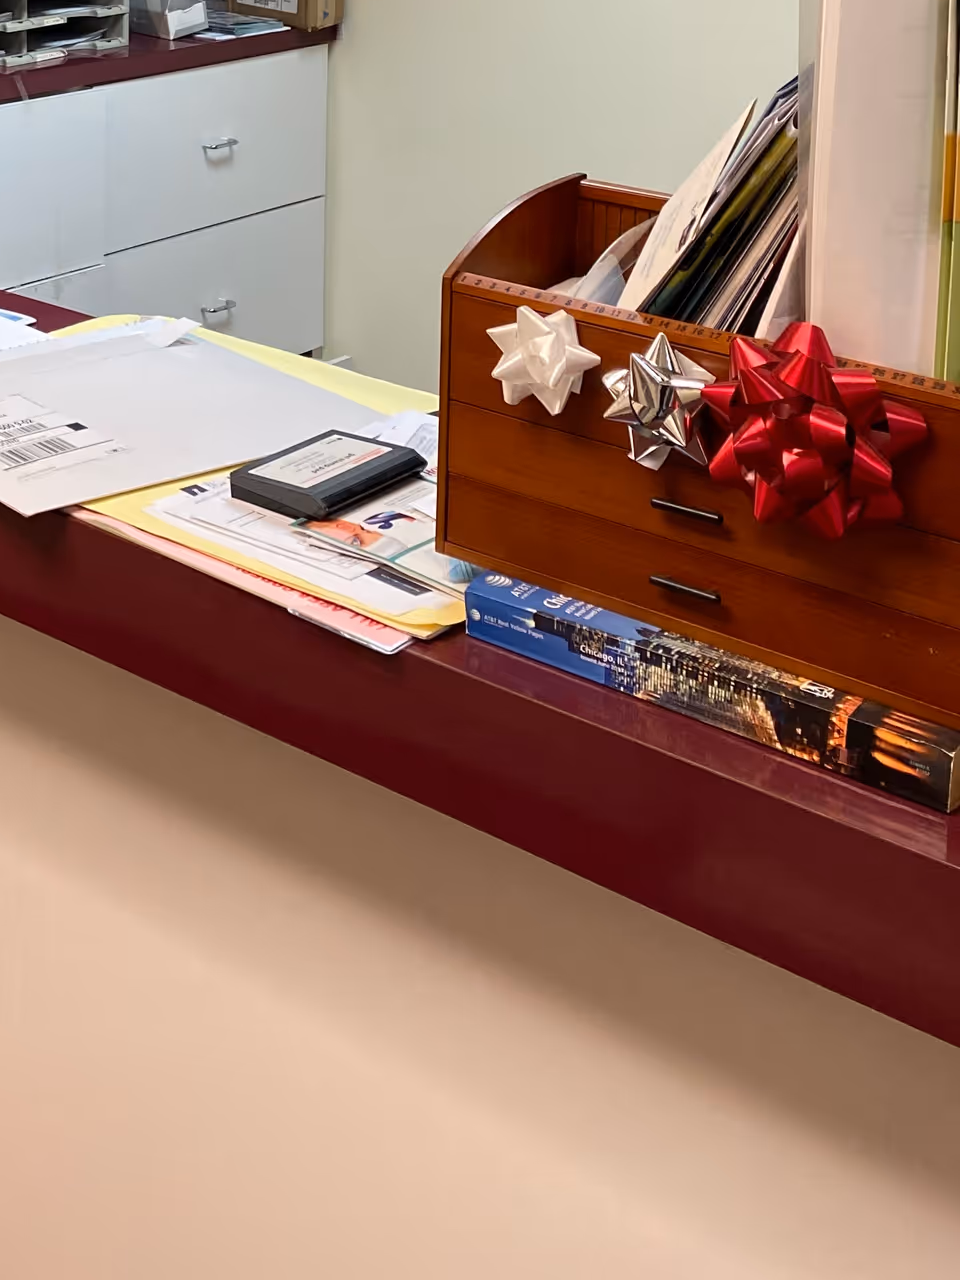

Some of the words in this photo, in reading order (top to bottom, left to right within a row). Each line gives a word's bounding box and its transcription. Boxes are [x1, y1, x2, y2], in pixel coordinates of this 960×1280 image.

[658, 320, 669, 328] 14
[692, 327, 704, 335] 16
[709, 331, 721, 339] 17
[510, 582, 532, 598] AT&T
[483, 615, 497, 624] AT&T
[580, 644, 616, 665] Chicago,
[617, 656, 625, 666] IL
